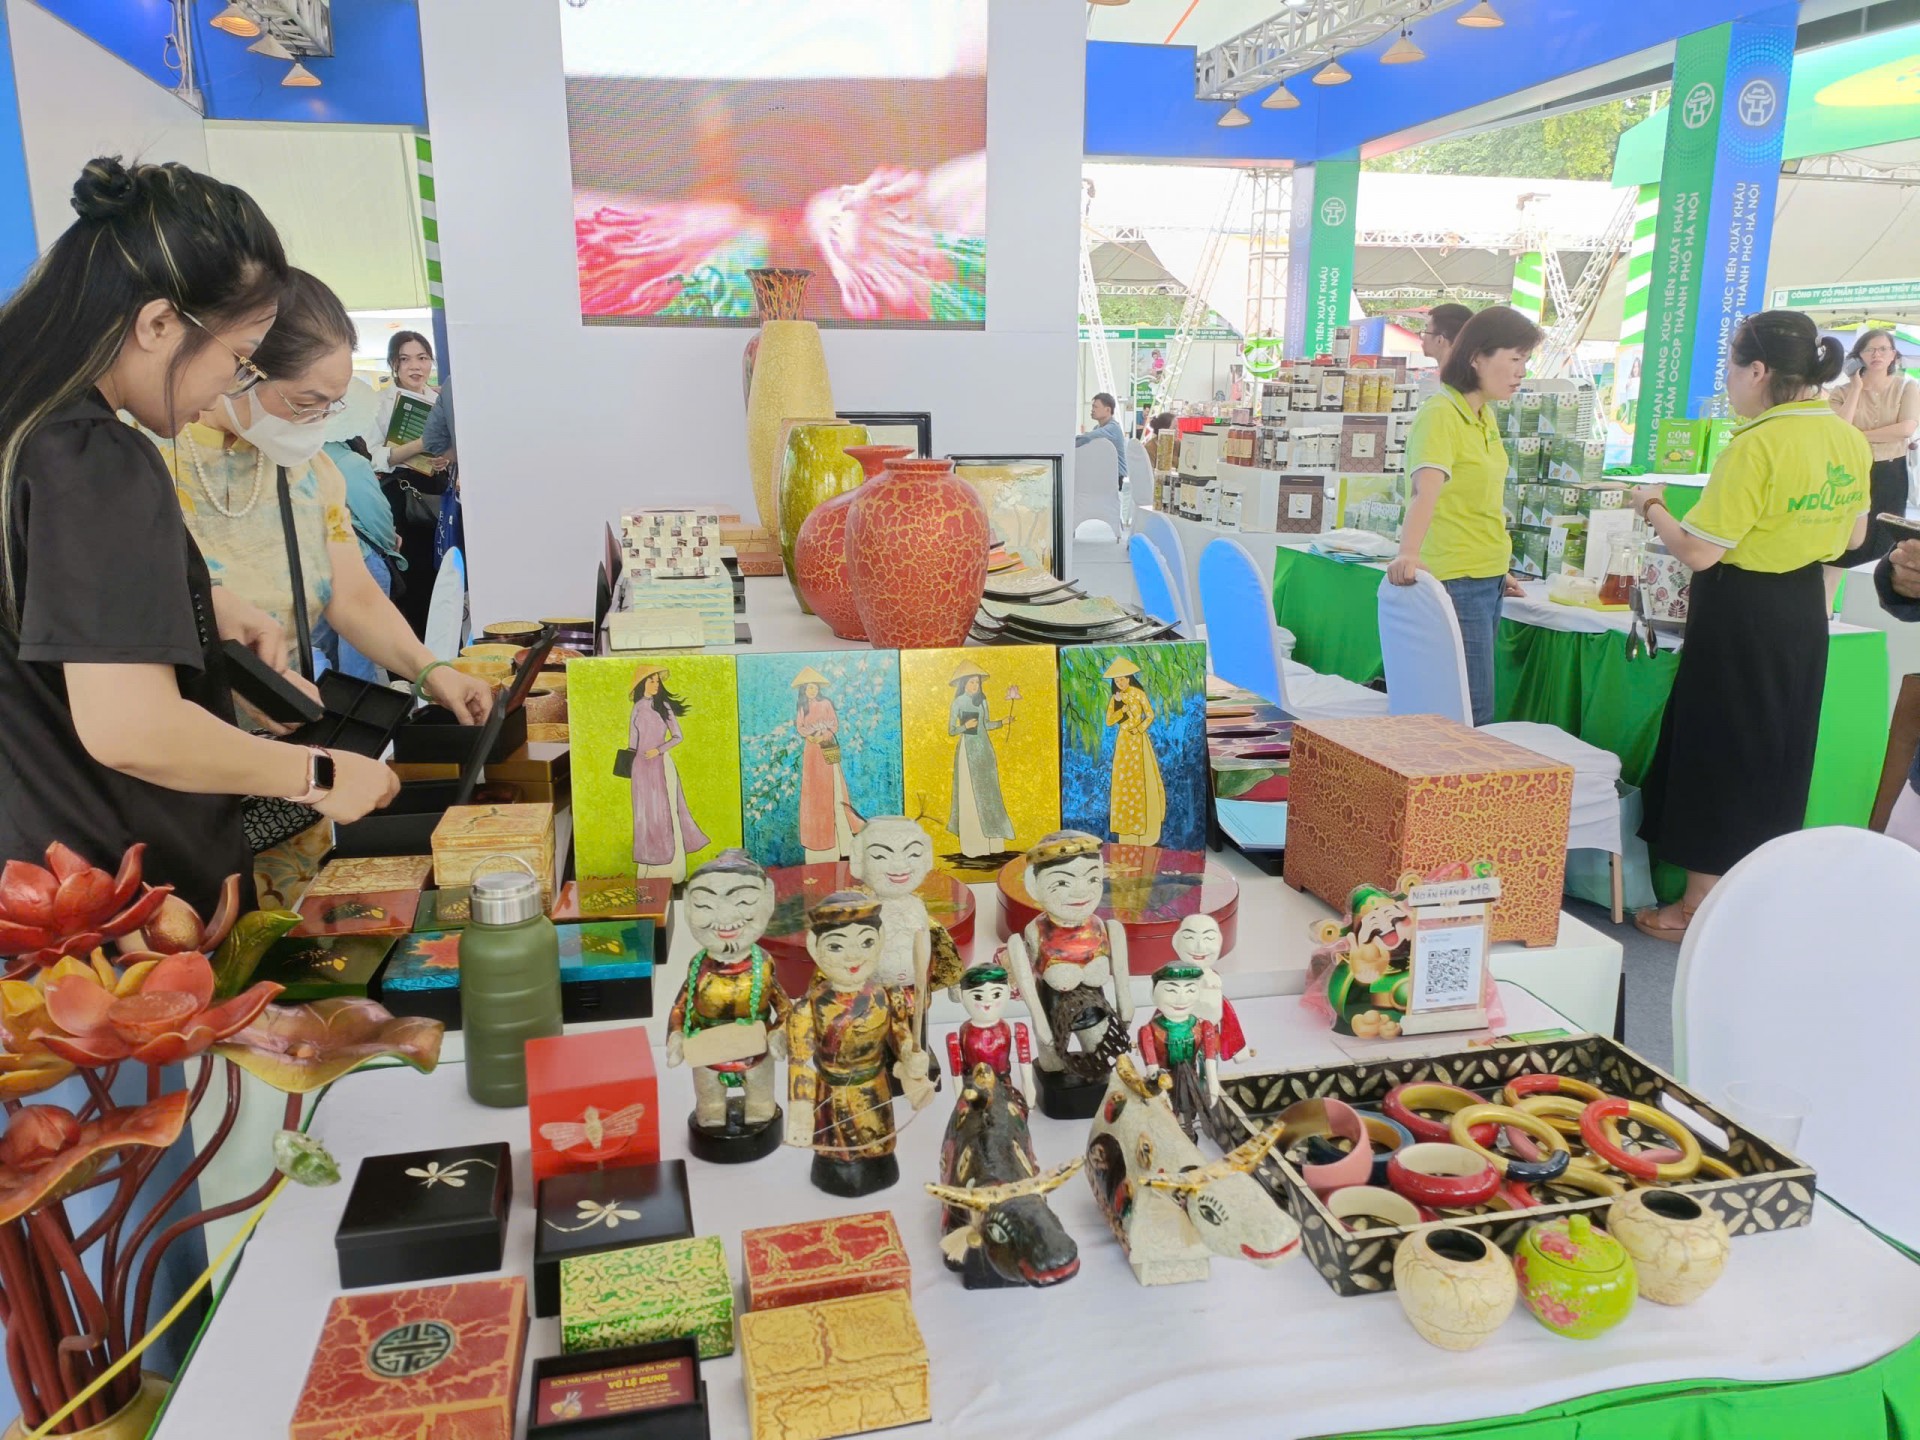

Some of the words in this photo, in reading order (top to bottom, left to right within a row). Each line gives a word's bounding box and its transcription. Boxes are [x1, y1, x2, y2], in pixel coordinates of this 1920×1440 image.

[1687, 192, 1700, 221] NỘI
[1733, 182, 1746, 218] KHẨU
[1747, 184, 1760, 209] NỘI
[1672, 193, 1687, 233] KHẨU
[1744, 212, 1757, 231] HÀ
[1684, 224, 1696, 247] HÀ
[1728, 222, 1742, 254] XUẤT
[1741, 235, 1754, 262] PHỐ
[1668, 238, 1682, 275] XUẤT
[1680, 250, 1692, 282] PHỐ
[1725, 257, 1738, 282] TIẾN
[1330, 267, 1340, 287] NỘI
[1736, 265, 1750, 306] THÀNH
[1317, 295, 1327, 319] XUẤT
[1328, 289, 1338, 303] HÀ
[1664, 278, 1677, 308] TIẾN
[1721, 286, 1734, 313] XÚC
[1327, 304, 1337, 325] PHỐ
[1674, 286, 1689, 334] THÀNH
[1315, 321, 1325, 341] TIẾN
[1325, 327, 1335, 354] HÀNH
[1660, 311, 1672, 342] XÚC
[1717, 317, 1730, 355] HÀNG
[1656, 346, 1669, 389] HÀNG
[1669, 338, 1682, 383] OCOP
[1714, 358, 1726, 391] GIAN
[1651, 393, 1663, 430] GIAN
[1648, 434, 1658, 461] KHU
